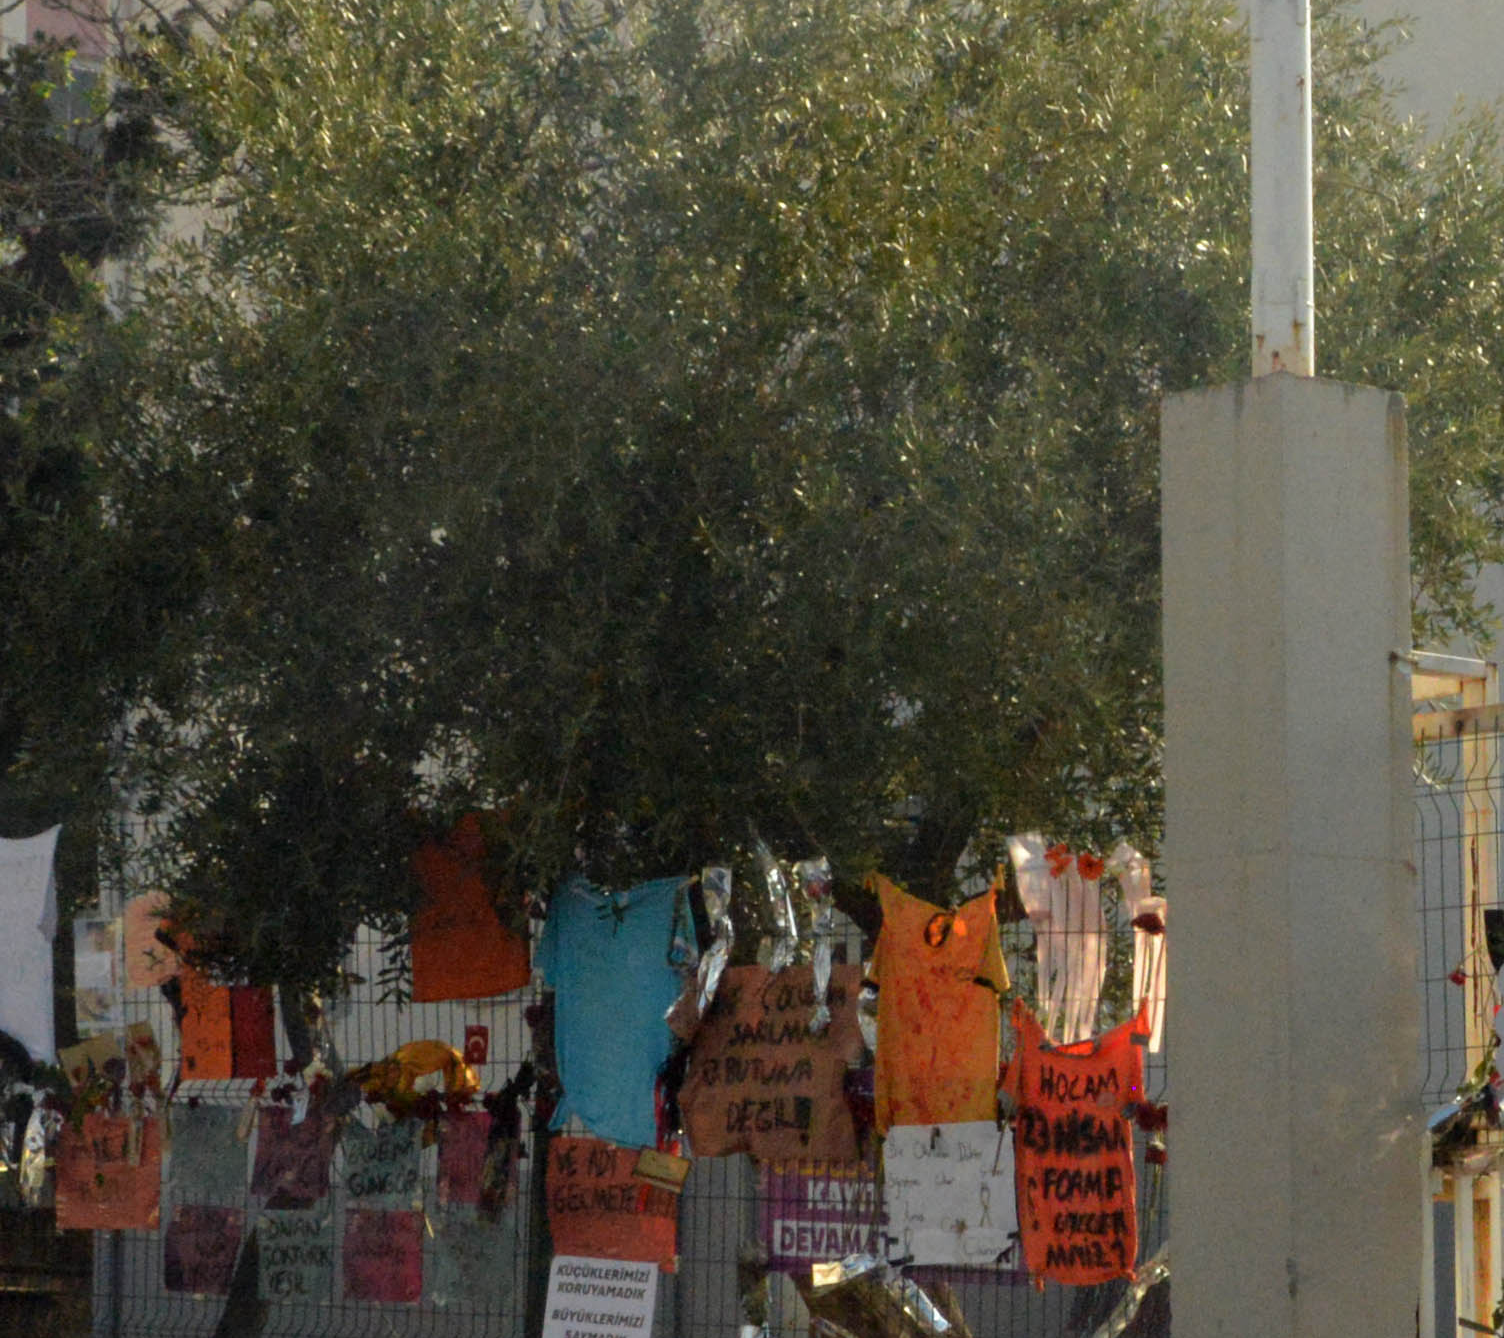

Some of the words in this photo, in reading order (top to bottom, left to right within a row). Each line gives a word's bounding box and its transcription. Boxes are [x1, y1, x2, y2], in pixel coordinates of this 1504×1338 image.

[1039, 1063, 1120, 1103] HOCAM
[781, 1224, 862, 1255] DEVAM
[556, 1262, 651, 1283] KÜÇÜKLERİMİZİ
[557, 1282, 646, 1300] KORUYAMADIK
[552, 1307, 645, 1329] BÜYÜKLERİMİZİ
